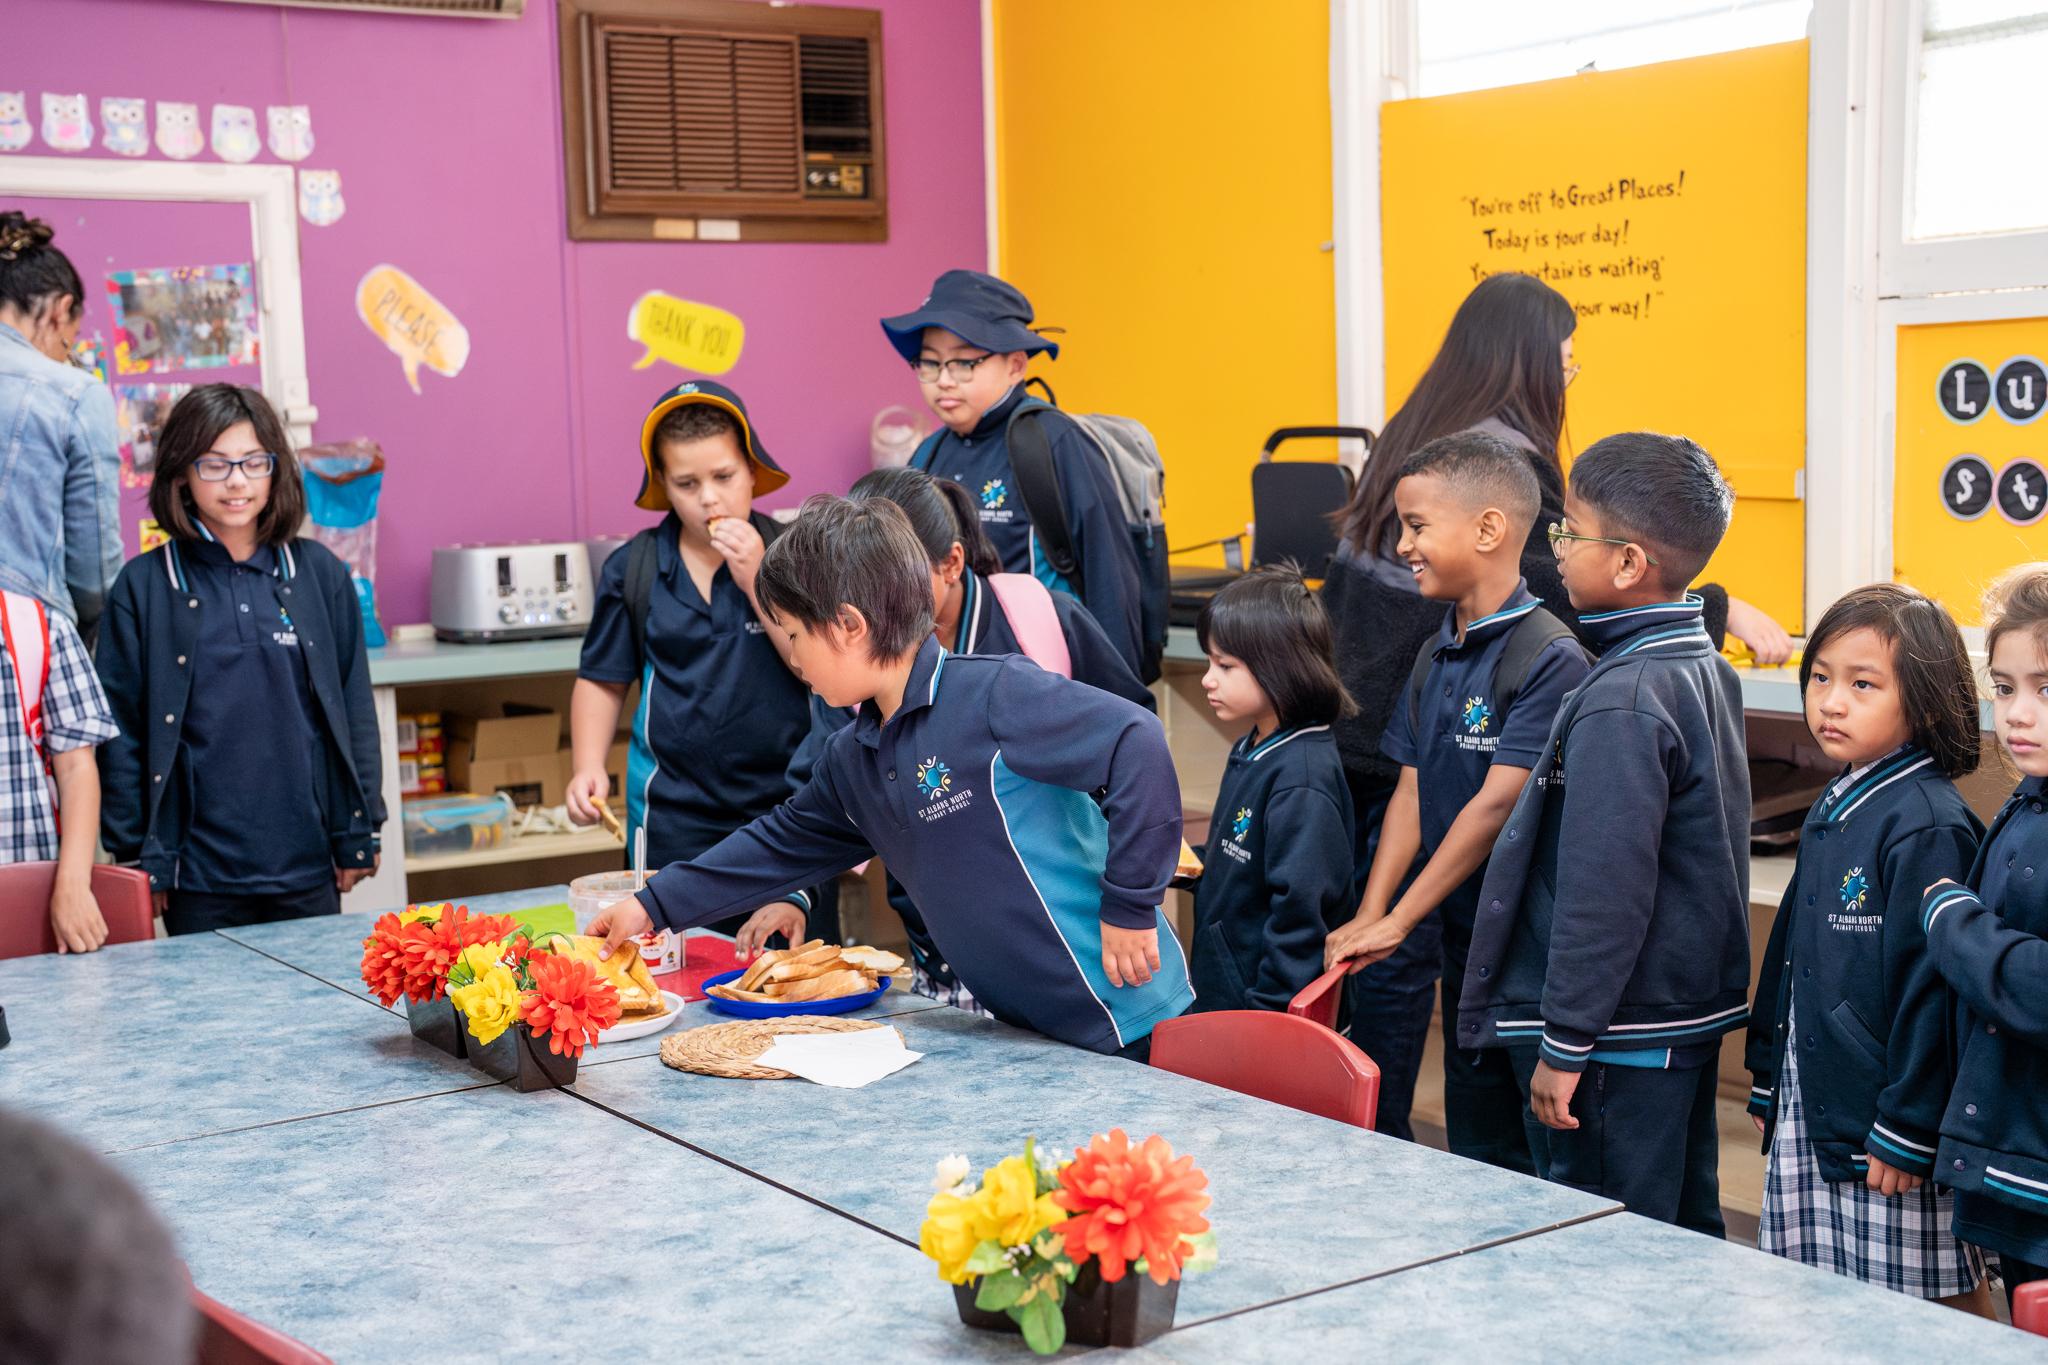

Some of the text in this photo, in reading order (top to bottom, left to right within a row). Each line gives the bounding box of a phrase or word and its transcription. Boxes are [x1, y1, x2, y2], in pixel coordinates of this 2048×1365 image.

[1519, 192, 1542, 214] off
[1549, 188, 1565, 209] to
[1567, 184, 1615, 206] Great
[1618, 170, 1685, 200] Places!
[1483, 219, 1629, 252] Today is your day!
[1578, 259, 1592, 278] is
[373, 287, 444, 356] PLEASE
[648, 301, 732, 358] THANK YOU
[1537, 777, 1547, 786] ST
[918, 788, 973, 819] ST ALBANS NORTH
[925, 799, 971, 823] PRIMARY SCHOOL
[1828, 913, 1837, 923] ST
[1858, 915, 1883, 925] NORTH
[1854, 924, 1877, 932] SCHOOL
